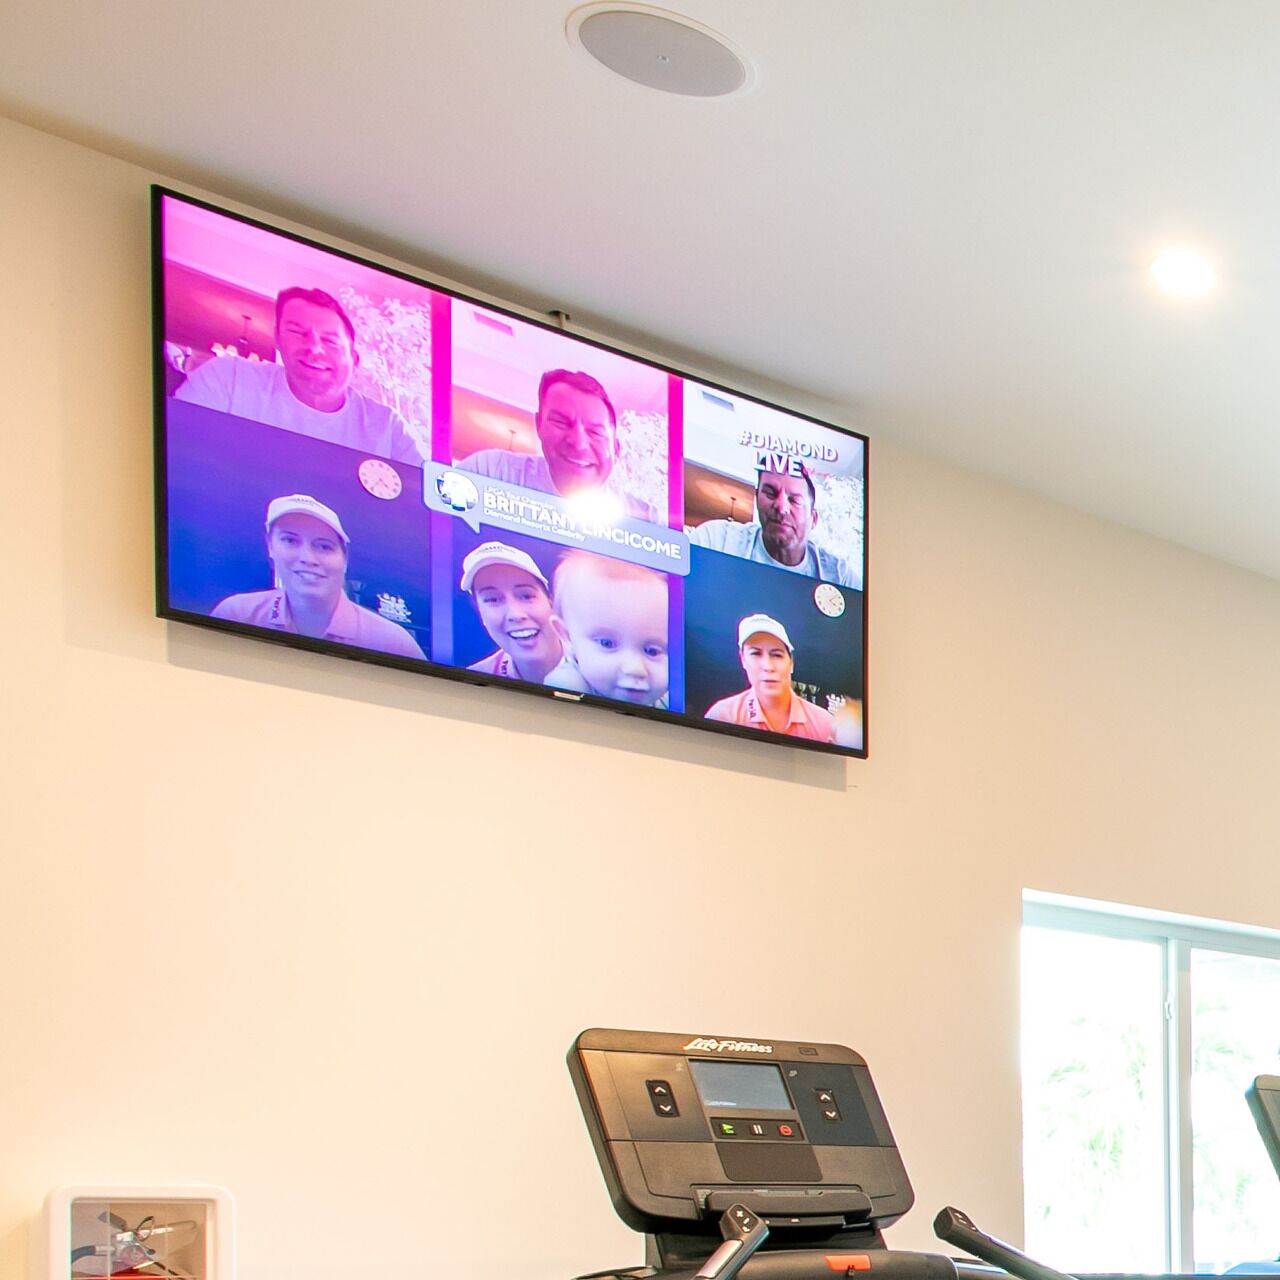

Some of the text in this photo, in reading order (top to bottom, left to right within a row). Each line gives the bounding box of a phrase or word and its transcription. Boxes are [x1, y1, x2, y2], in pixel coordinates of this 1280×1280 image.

[738, 430, 839, 462] #DIAMOND
[753, 450, 804, 478] LIVE
[483, 495, 578, 531] BRITTANY
